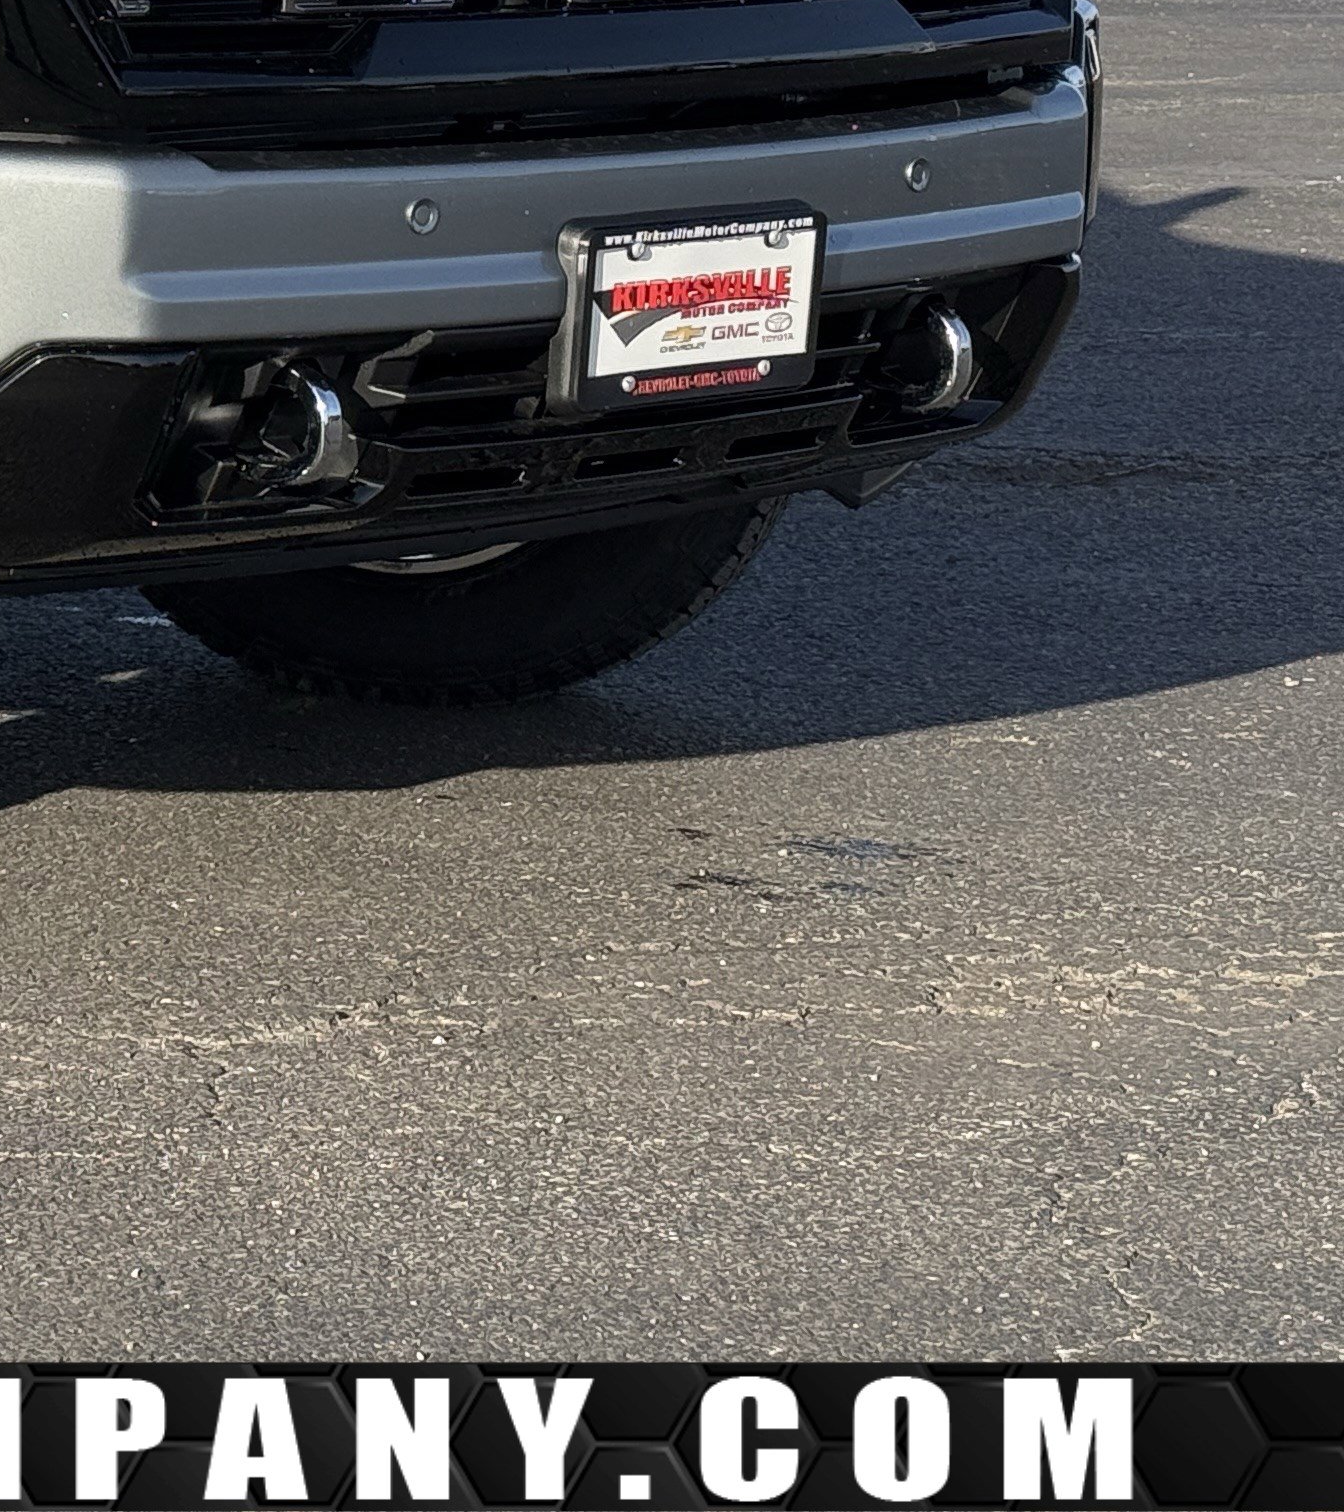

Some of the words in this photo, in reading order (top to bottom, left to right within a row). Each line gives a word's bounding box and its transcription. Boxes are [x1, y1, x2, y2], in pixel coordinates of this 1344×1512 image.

[611, 265, 792, 312] KIRKSVILLE
[680, 305, 725, 321] MOTOR
[727, 298, 790, 316] COMPANY
[711, 321, 761, 341] GMC
